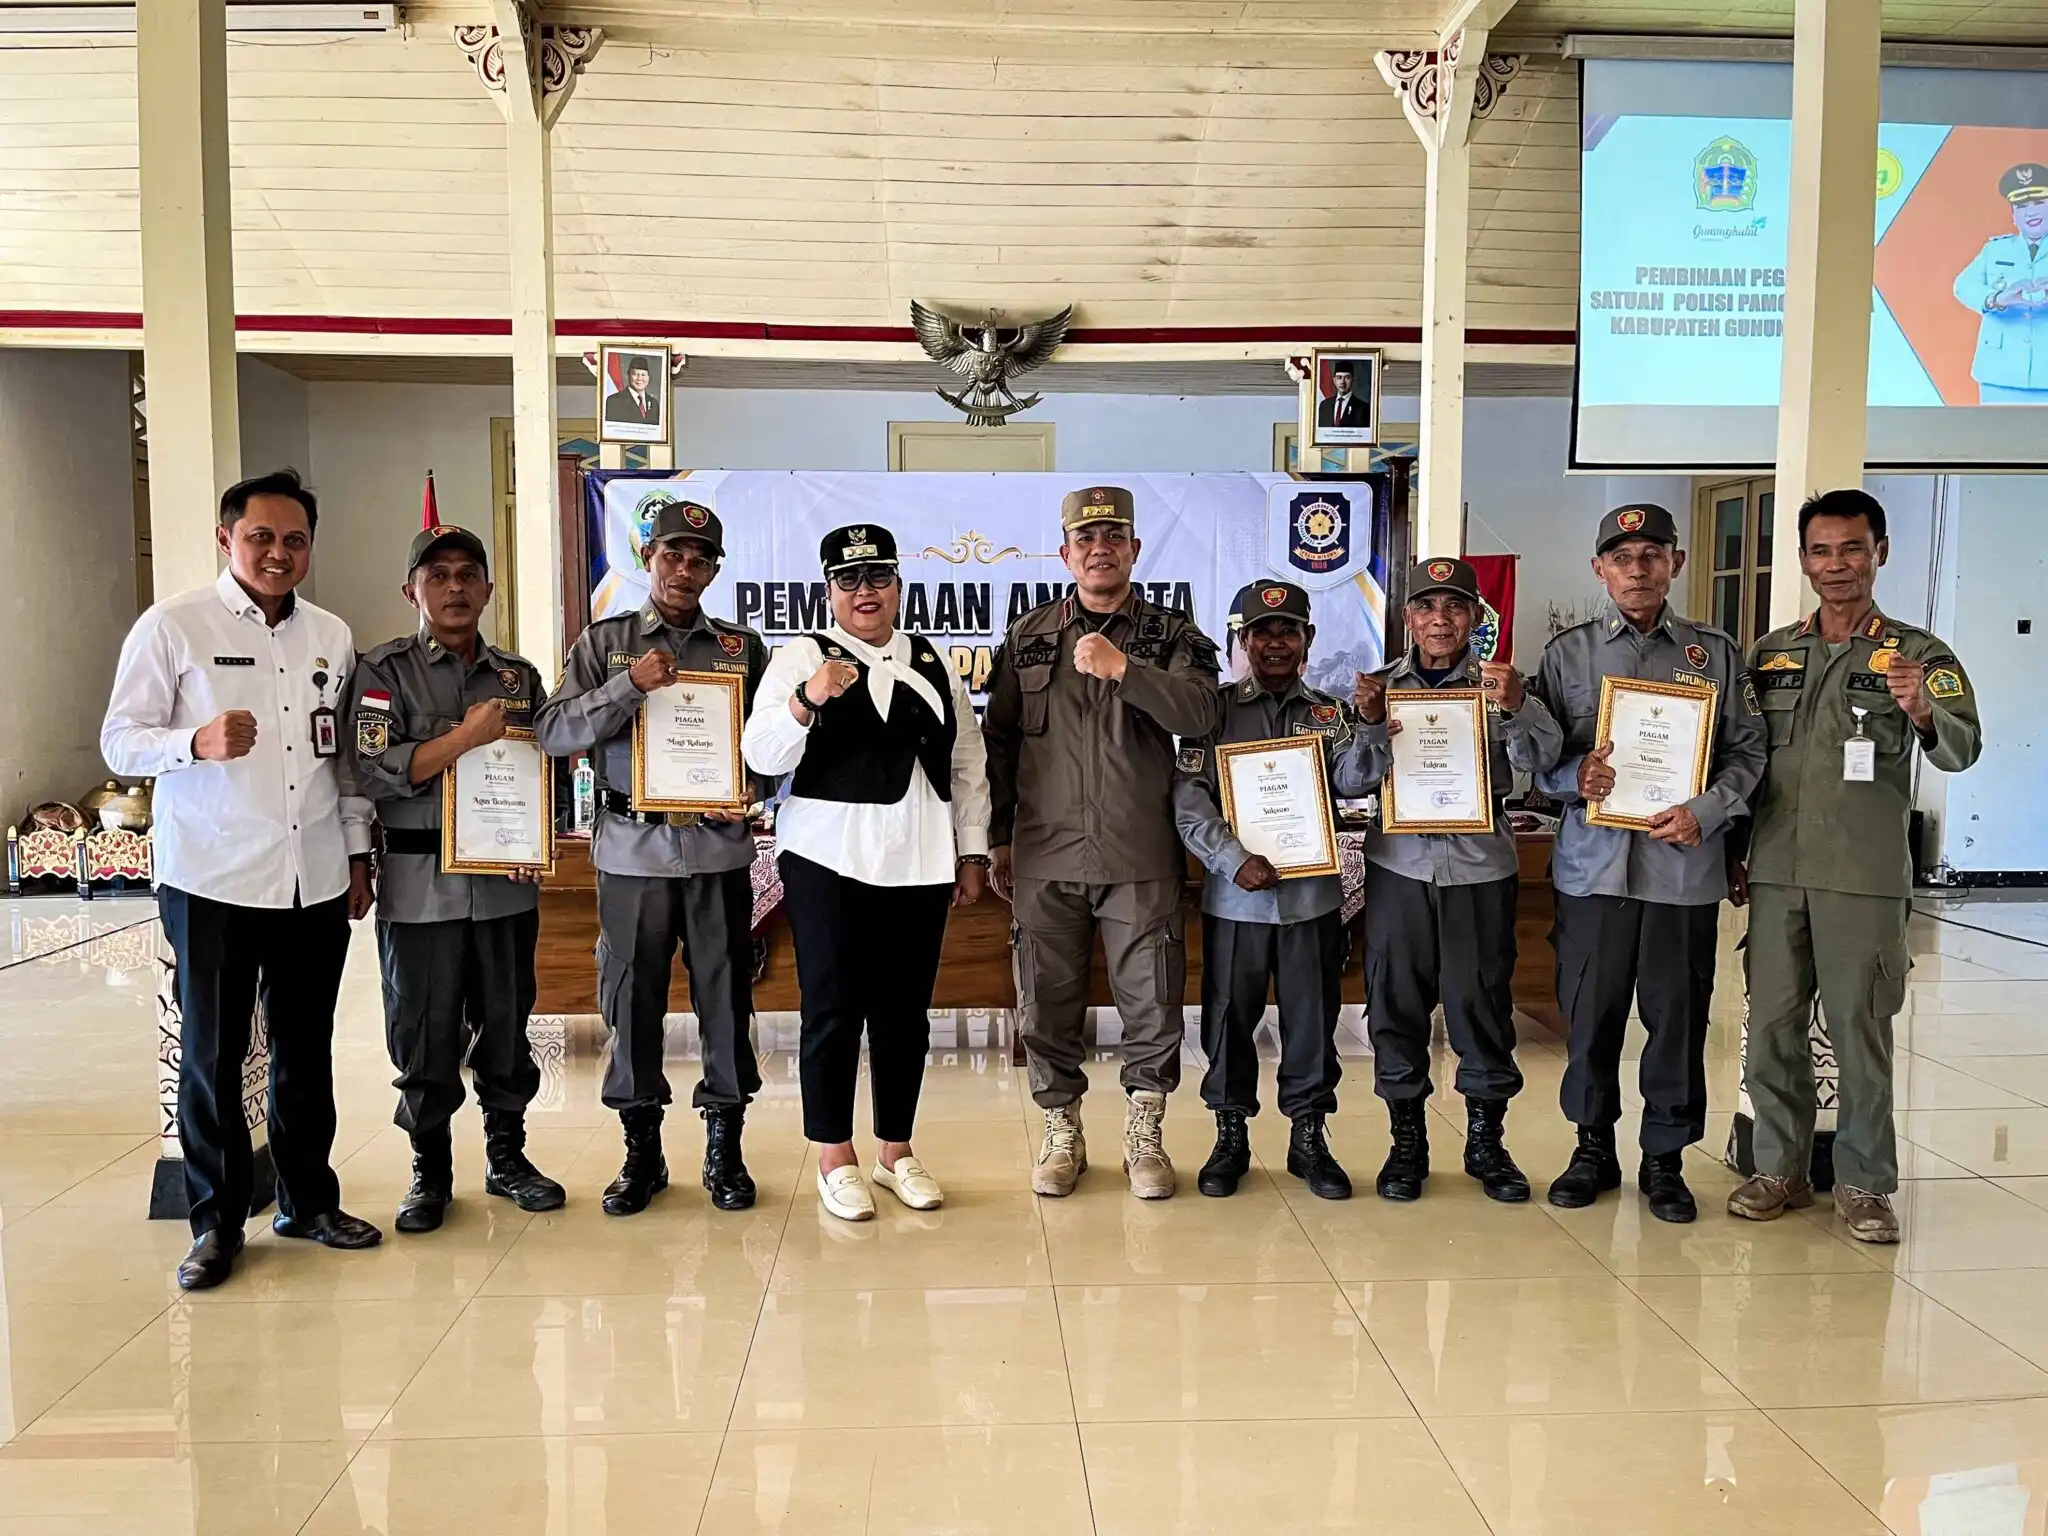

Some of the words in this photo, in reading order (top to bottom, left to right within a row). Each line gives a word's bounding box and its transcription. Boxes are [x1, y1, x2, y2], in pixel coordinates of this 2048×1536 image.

[1635, 266, 1746, 287] PEMBINAAN
[1590, 291, 1664, 311] SATUAN
[1673, 293, 1733, 312] POLISI
[1610, 316, 1720, 336] KABUPATEN
[735, 581, 993, 633] PEMAAN
[675, 716, 704, 724] PIAGAM
[1640, 730, 1669, 740] PIAGAM
[485, 774, 515, 782] PIAGAM
[1259, 783, 1288, 792] PIAGAM
